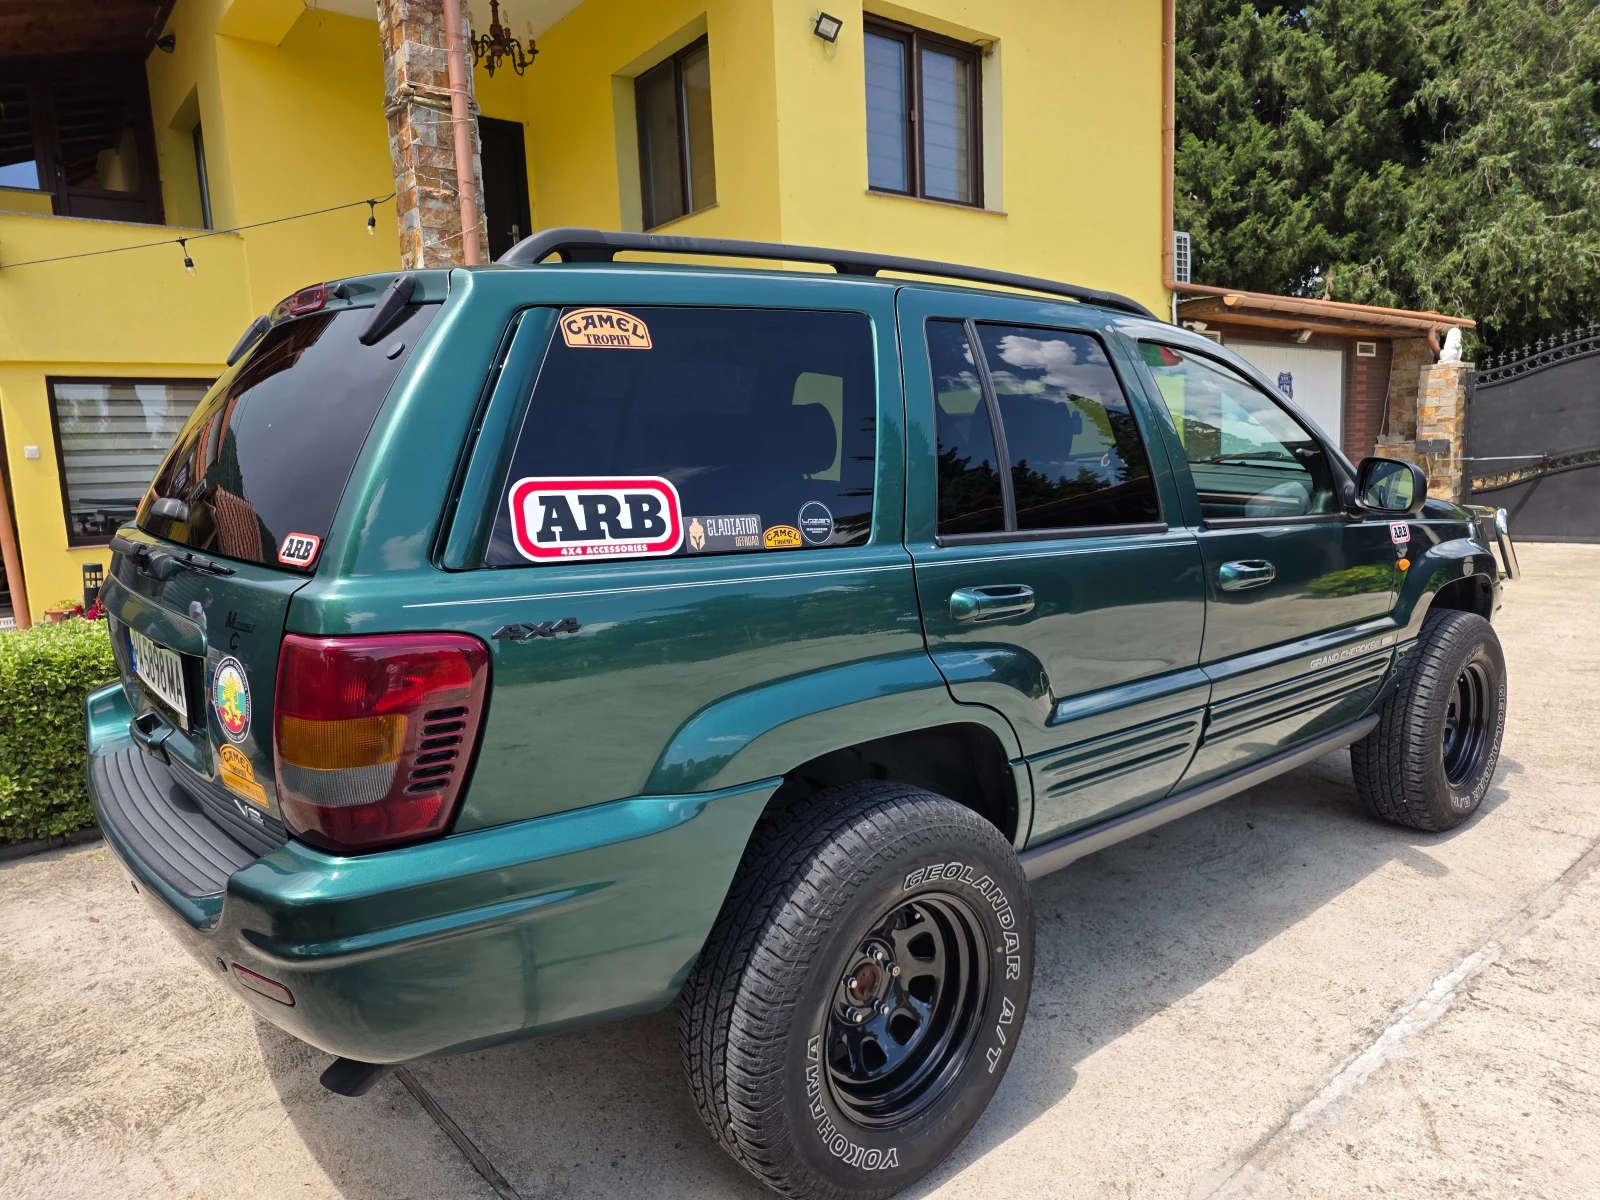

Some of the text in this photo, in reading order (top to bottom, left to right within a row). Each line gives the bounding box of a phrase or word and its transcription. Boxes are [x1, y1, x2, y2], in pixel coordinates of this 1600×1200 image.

[566, 314, 645, 340] CAMEL
[584, 333, 631, 345] TROPHY
[536, 493, 667, 543] ARB
[766, 530, 799, 542] CAMEL
[1393, 525, 1408, 539] ARB
[282, 538, 314, 560] ARB
[560, 544, 648, 556] 4X4 ACCESSORIES
[1310, 652, 1340, 669] GRAND
[1340, 640, 1380, 659] CHEROKEE
[1472, 684, 1506, 802] GEOLANDAR
[223, 750, 252, 777] CAMEL
[902, 861, 1021, 981] GEOLANDAR
[986, 996, 1016, 1074] A/T
[806, 1034, 899, 1170] YOKOHAMA
